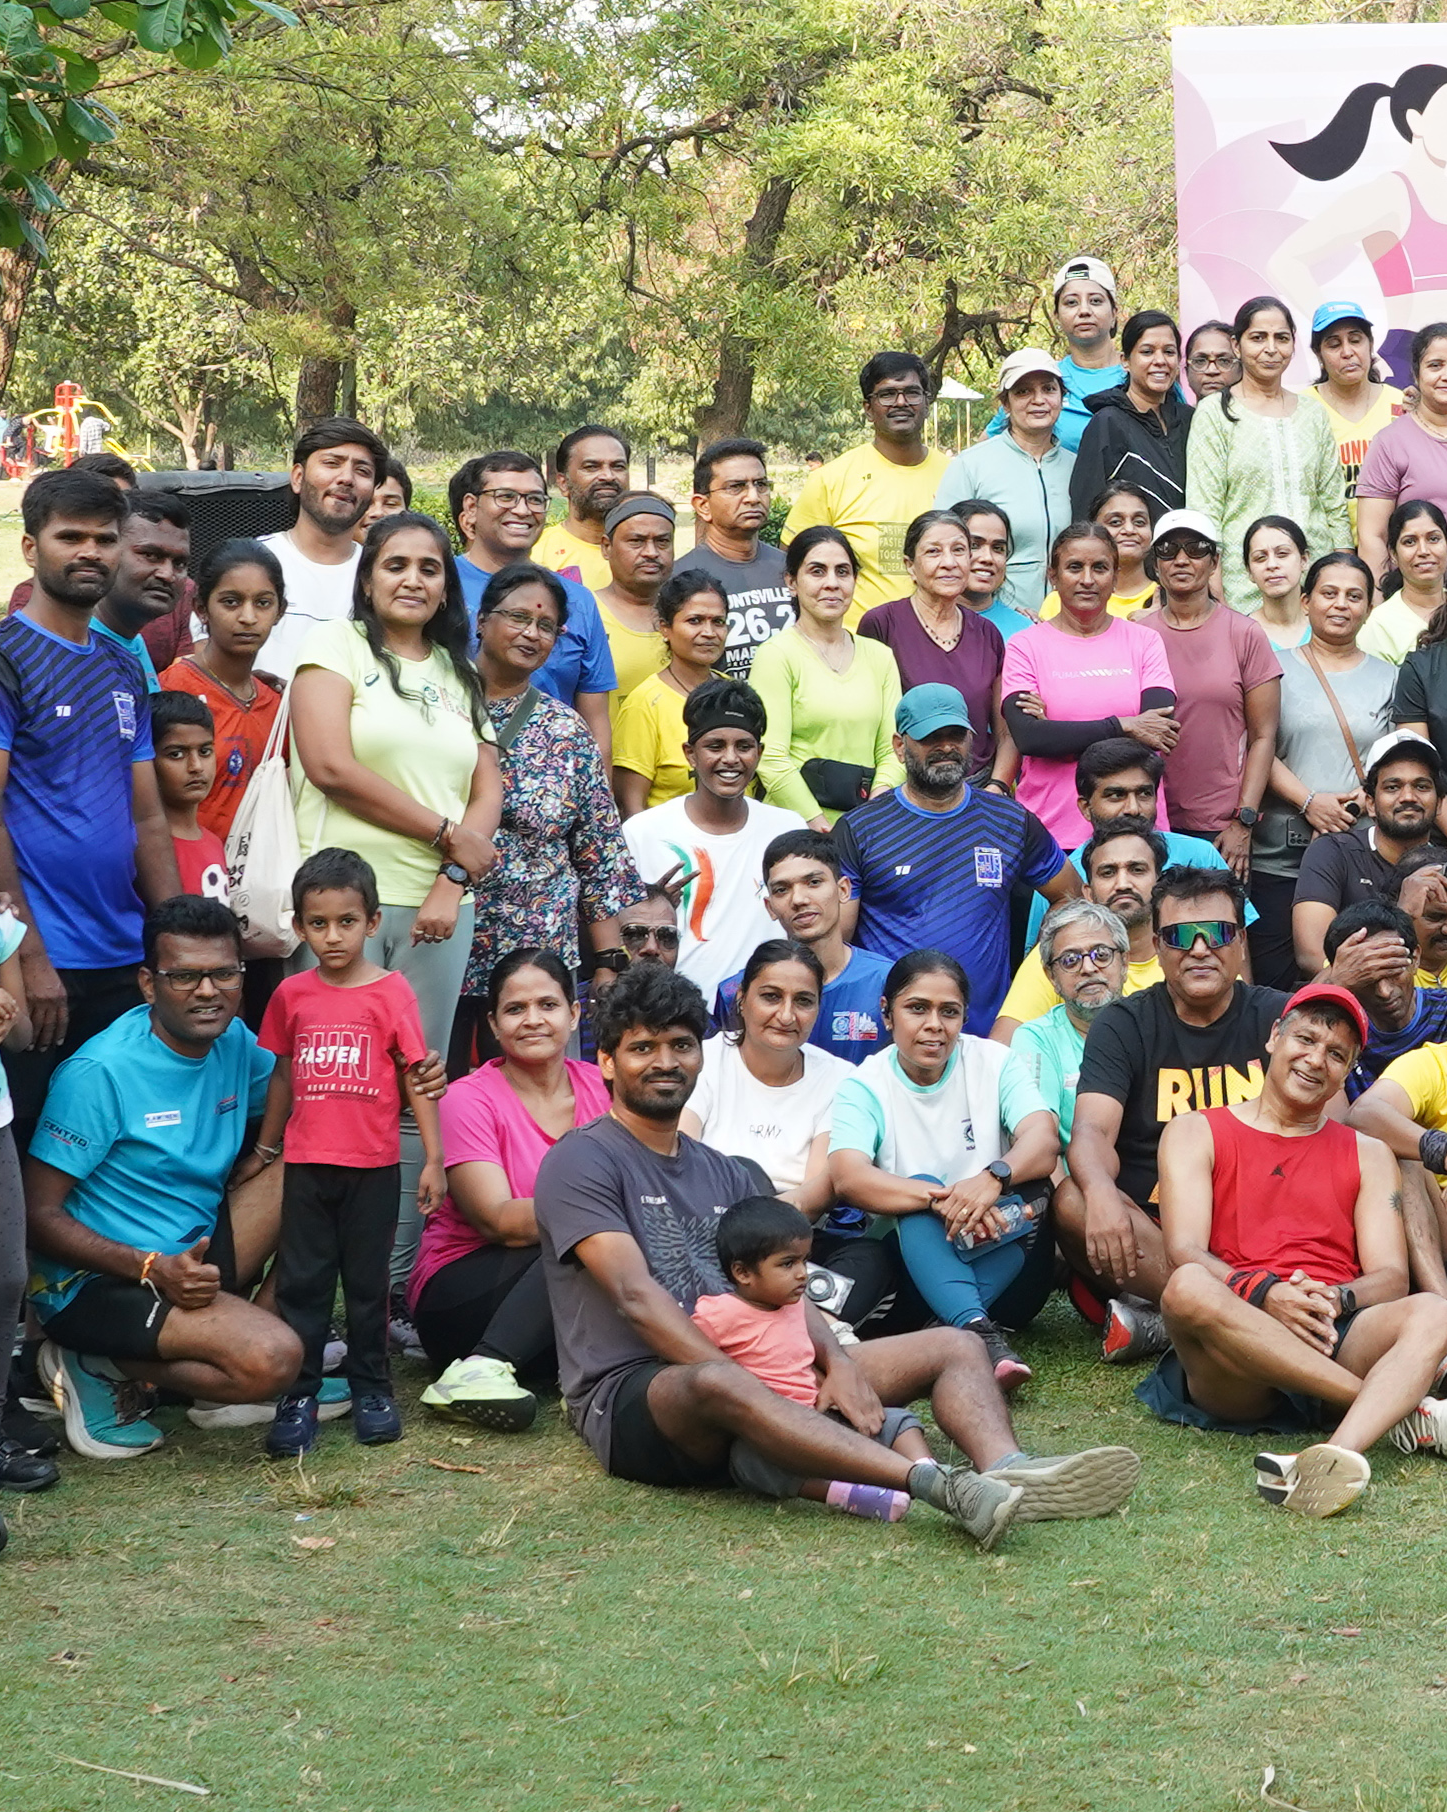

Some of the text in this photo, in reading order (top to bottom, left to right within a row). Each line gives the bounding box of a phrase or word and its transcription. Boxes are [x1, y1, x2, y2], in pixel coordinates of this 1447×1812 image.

[727, 586, 793, 610] UNTSVILLE
[725, 604, 797, 647] 26.2
[298, 1045, 361, 1065] FASTER
[1156, 1057, 1266, 1123] RUN
